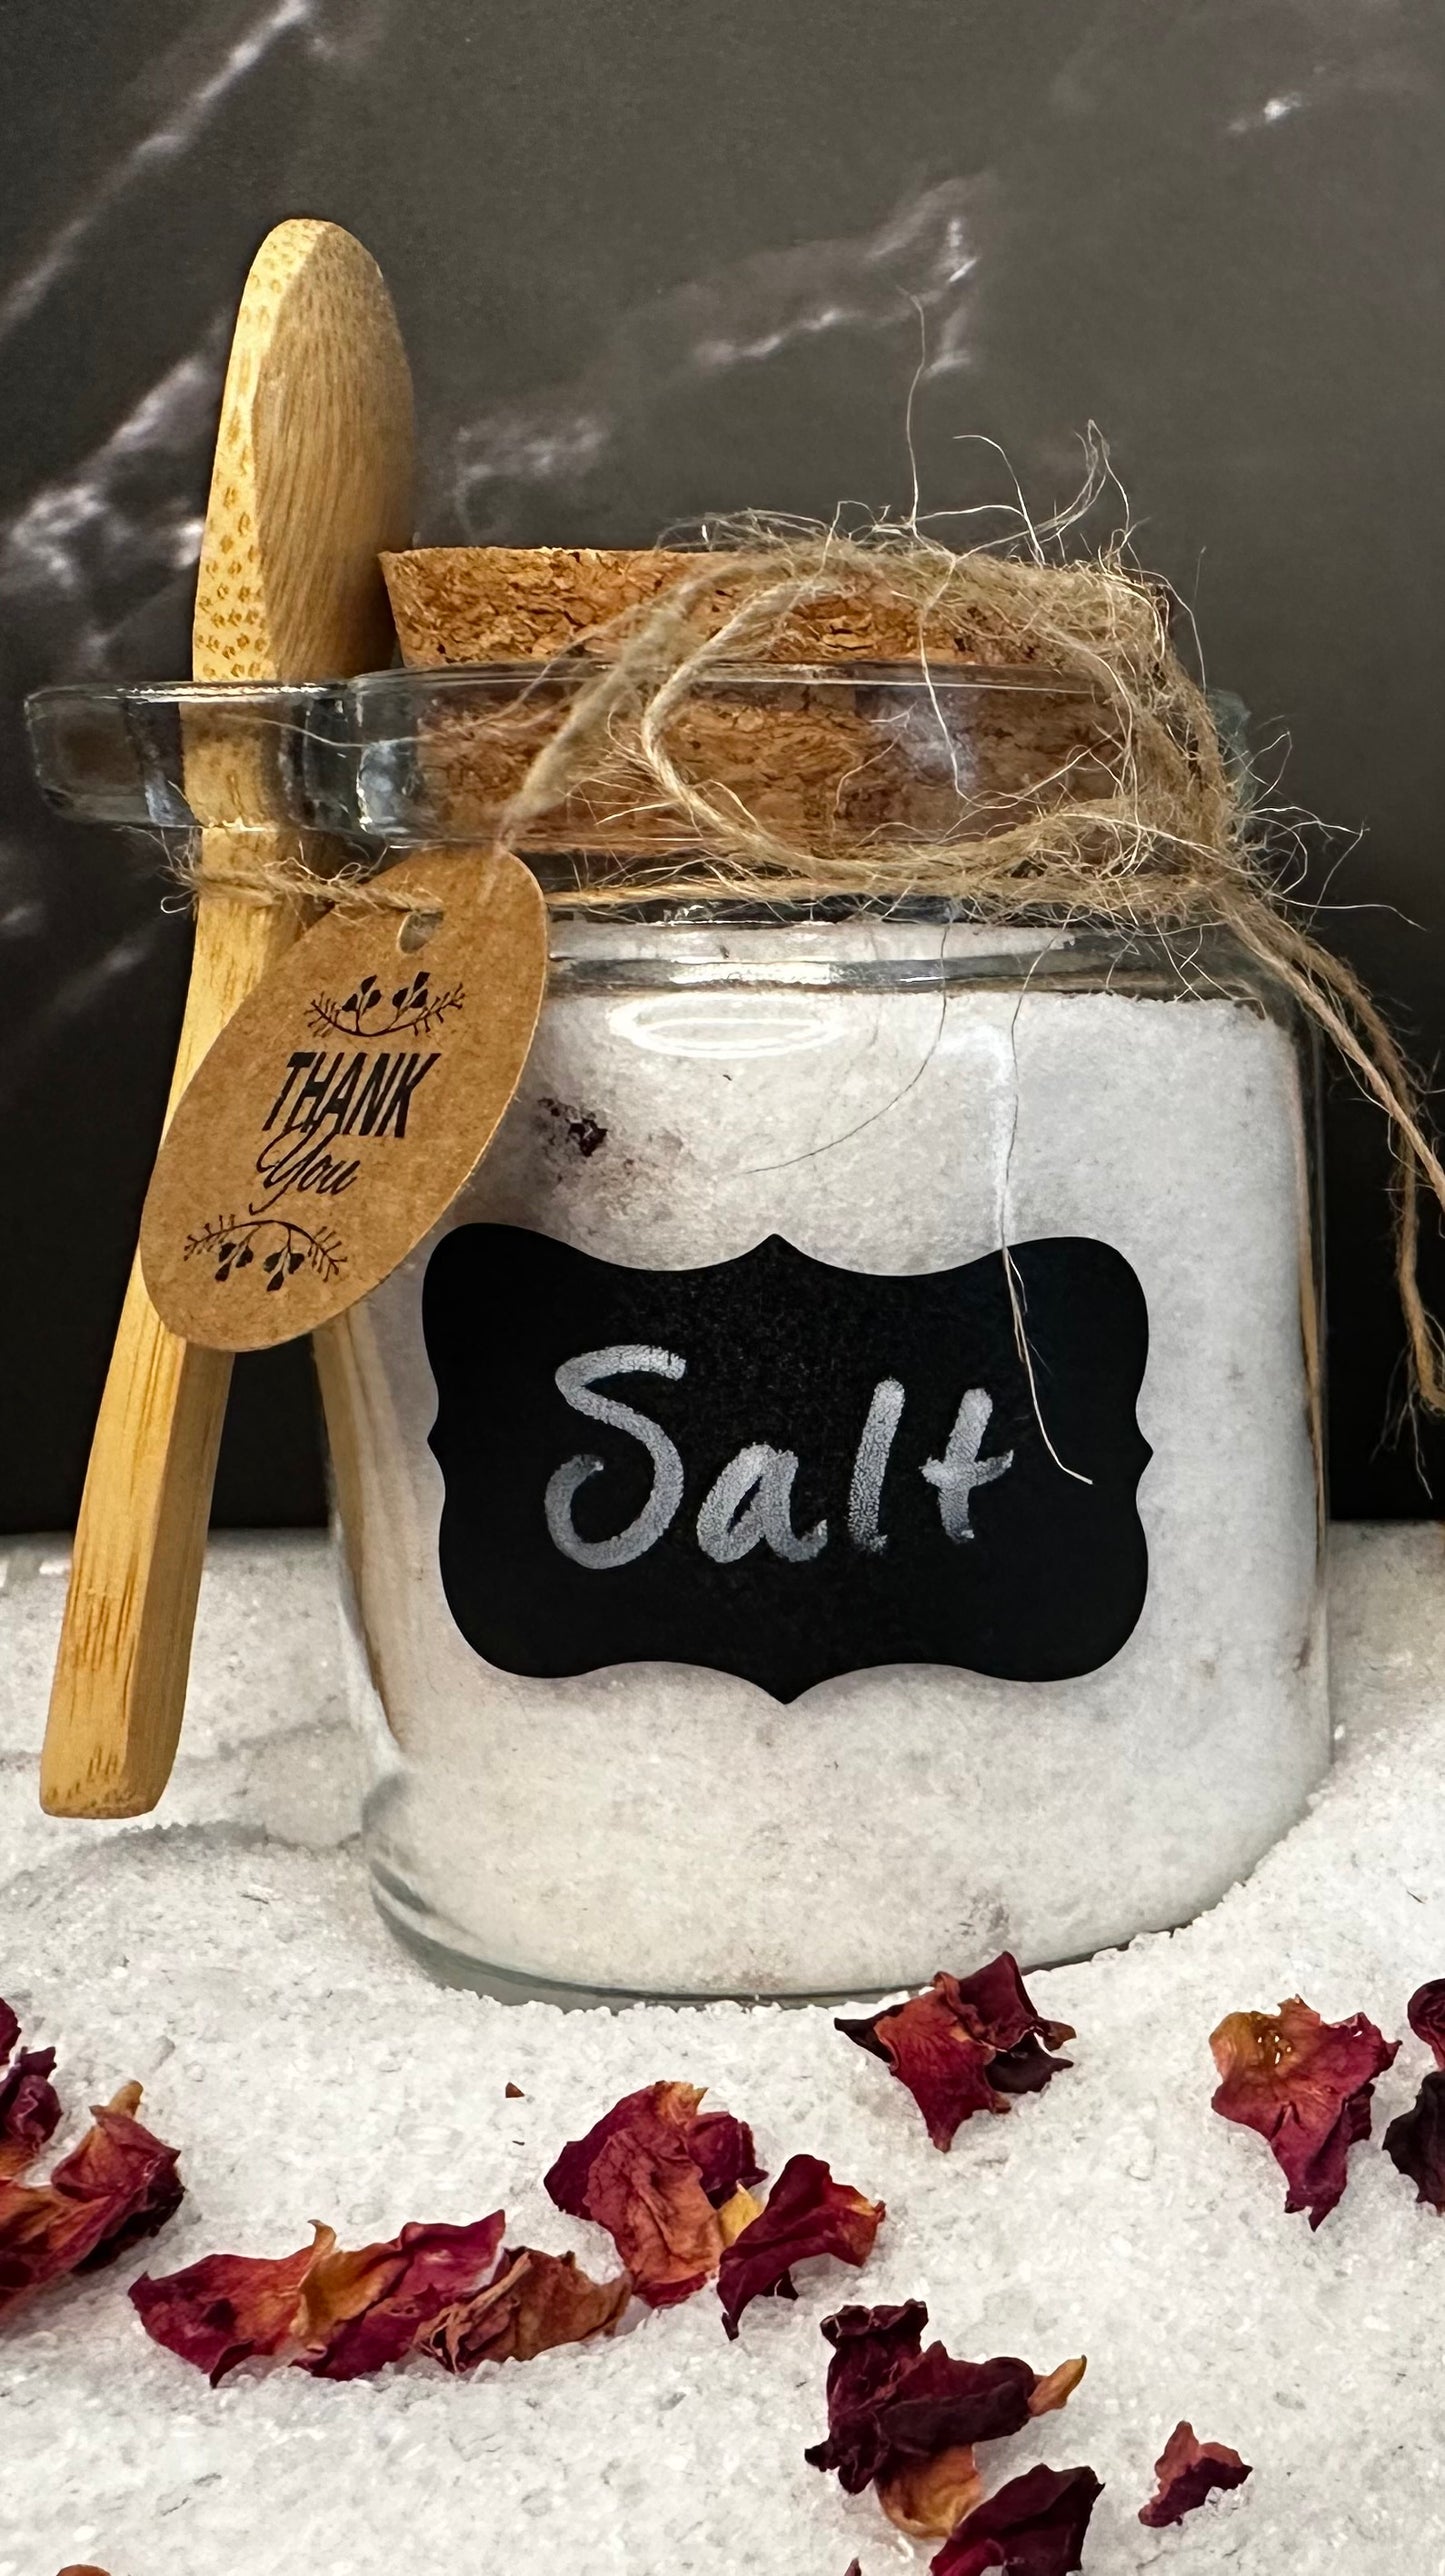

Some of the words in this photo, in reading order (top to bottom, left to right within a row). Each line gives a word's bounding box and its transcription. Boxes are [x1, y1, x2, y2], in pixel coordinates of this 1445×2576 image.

[262, 1052, 441, 1138] THANK
[249, 1123, 361, 1215] You
[544, 1343, 1014, 1569] Salt
